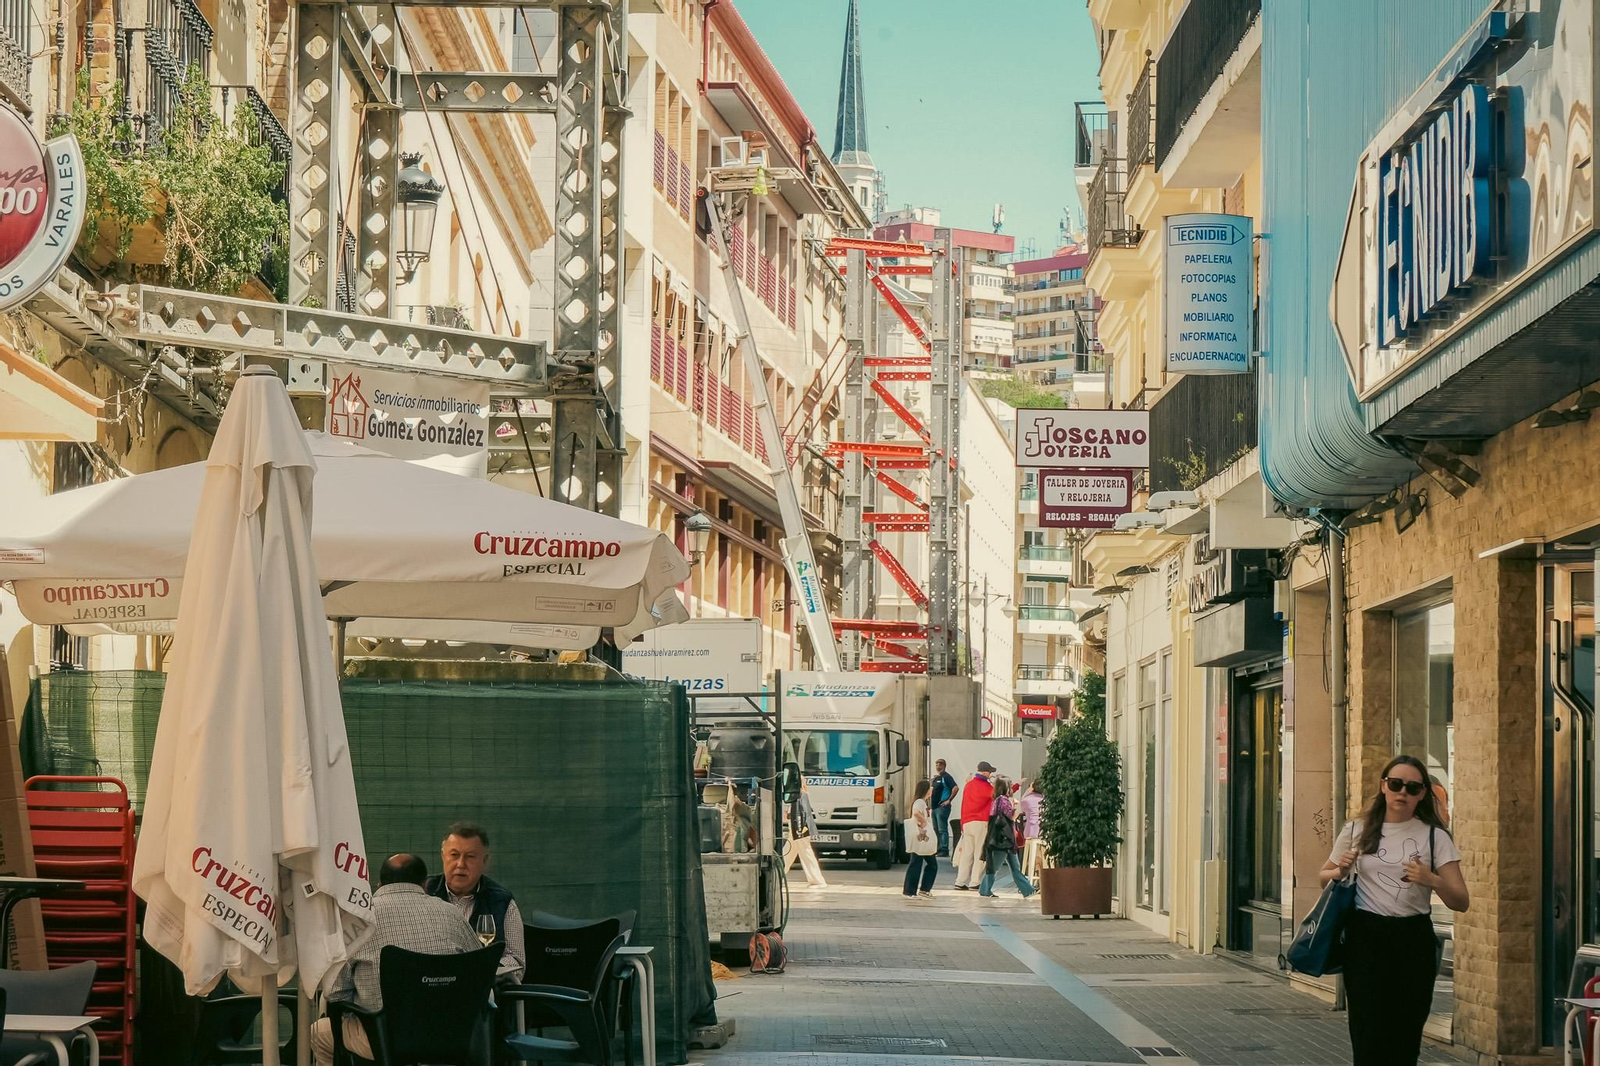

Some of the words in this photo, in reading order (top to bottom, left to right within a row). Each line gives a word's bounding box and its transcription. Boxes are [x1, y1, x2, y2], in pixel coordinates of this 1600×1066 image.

[44, 152, 75, 248] VARALES
[1173, 225, 1228, 242] TECNIDIB
[1184, 254, 1233, 265] PAPELERIA
[1181, 273, 1236, 284] FOTOCOPIAS
[1191, 293, 1228, 303] PLANOS
[1183, 312, 1235, 323] MOBILIARIO
[1179, 331, 1238, 343] INFORMATICA
[1169, 351, 1246, 363] ENCUADERNACION
[373, 389, 416, 409] Servicios
[416, 393, 481, 415] inmobiliarios
[417, 418, 484, 447] González
[1034, 417, 1147, 445] TOSCANO
[1025, 431, 1111, 459] JOYERIA
[1046, 478, 1077, 488] TALLER
[1079, 479, 1090, 488] DE
[1091, 479, 1126, 489] JOYERIA
[1060, 492, 1065, 502] Y
[1067, 493, 1112, 503] RELOJERIA
[1045, 512, 1081, 521] RELOJES
[473, 530, 622, 560] Cruzcampo
[503, 562, 586, 578] ESPECIAL
